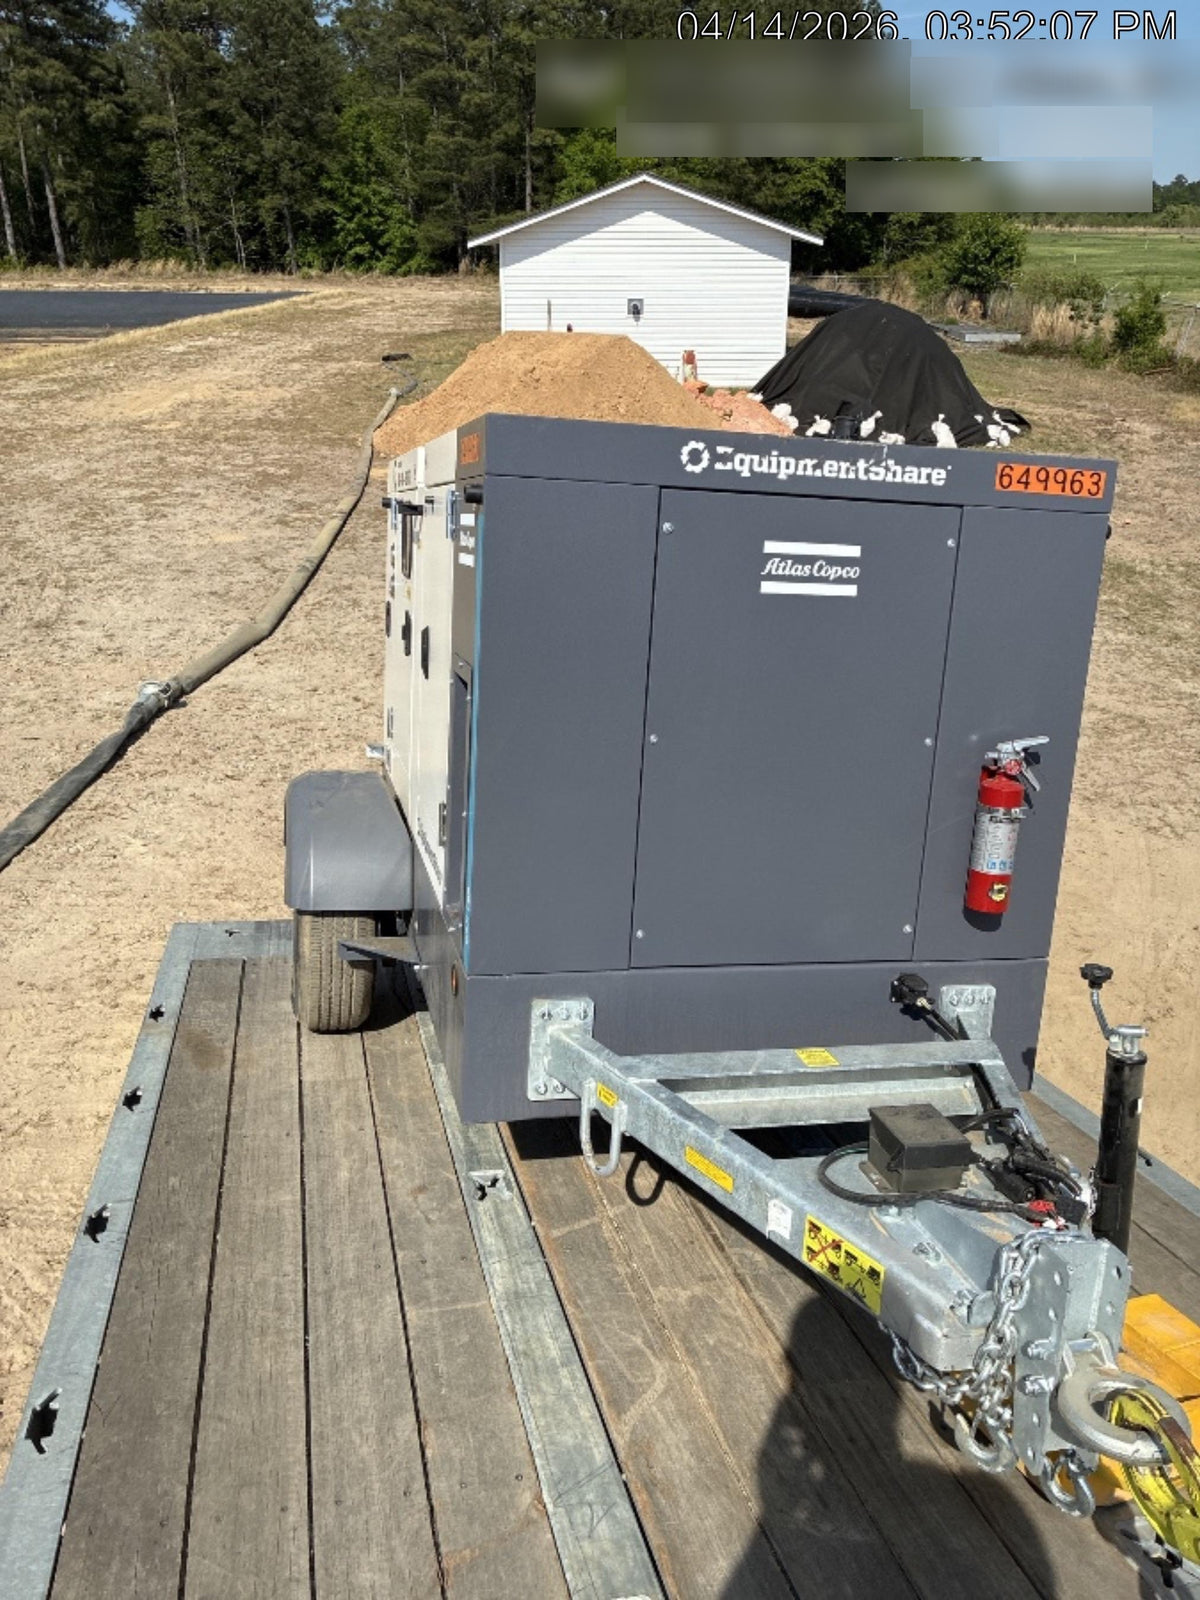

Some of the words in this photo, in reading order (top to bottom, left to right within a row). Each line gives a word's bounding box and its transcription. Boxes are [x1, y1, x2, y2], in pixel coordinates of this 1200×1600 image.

[998, 464, 1102, 497] 649963
[760, 557, 812, 577] Atlas
[812, 559, 860, 582] Copco
